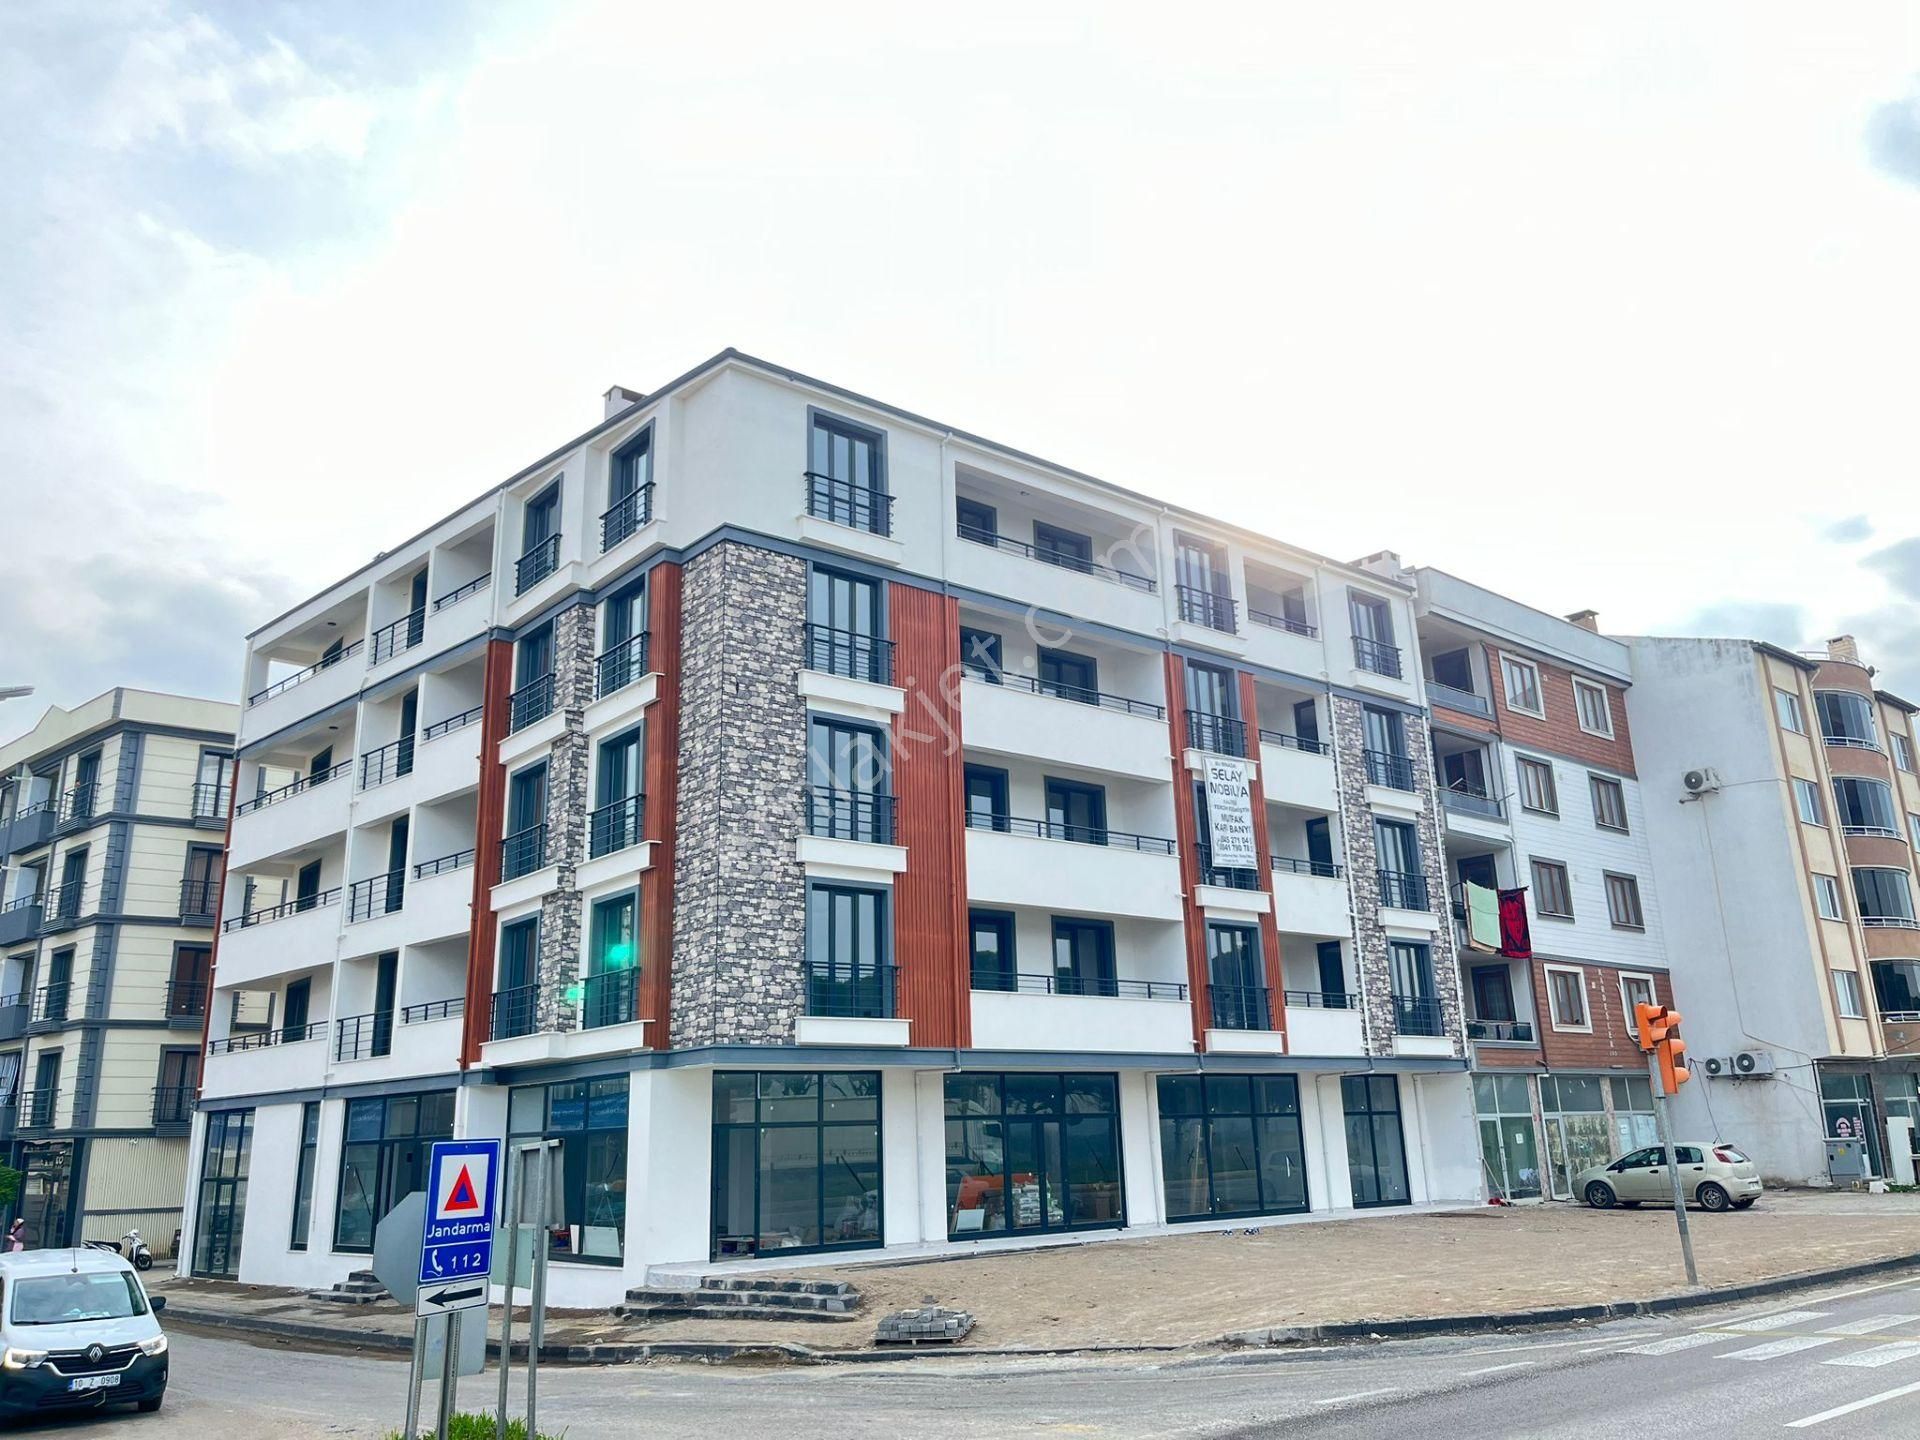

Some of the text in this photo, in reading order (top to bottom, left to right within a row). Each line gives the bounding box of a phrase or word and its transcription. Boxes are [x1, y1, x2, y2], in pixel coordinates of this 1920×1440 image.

[1211, 768, 1242, 782] SELAY
[427, 1222, 490, 1238] Jandarma
[451, 1253, 481, 1269] 112
[74, 1376, 119, 1388] 10 Z 0908
